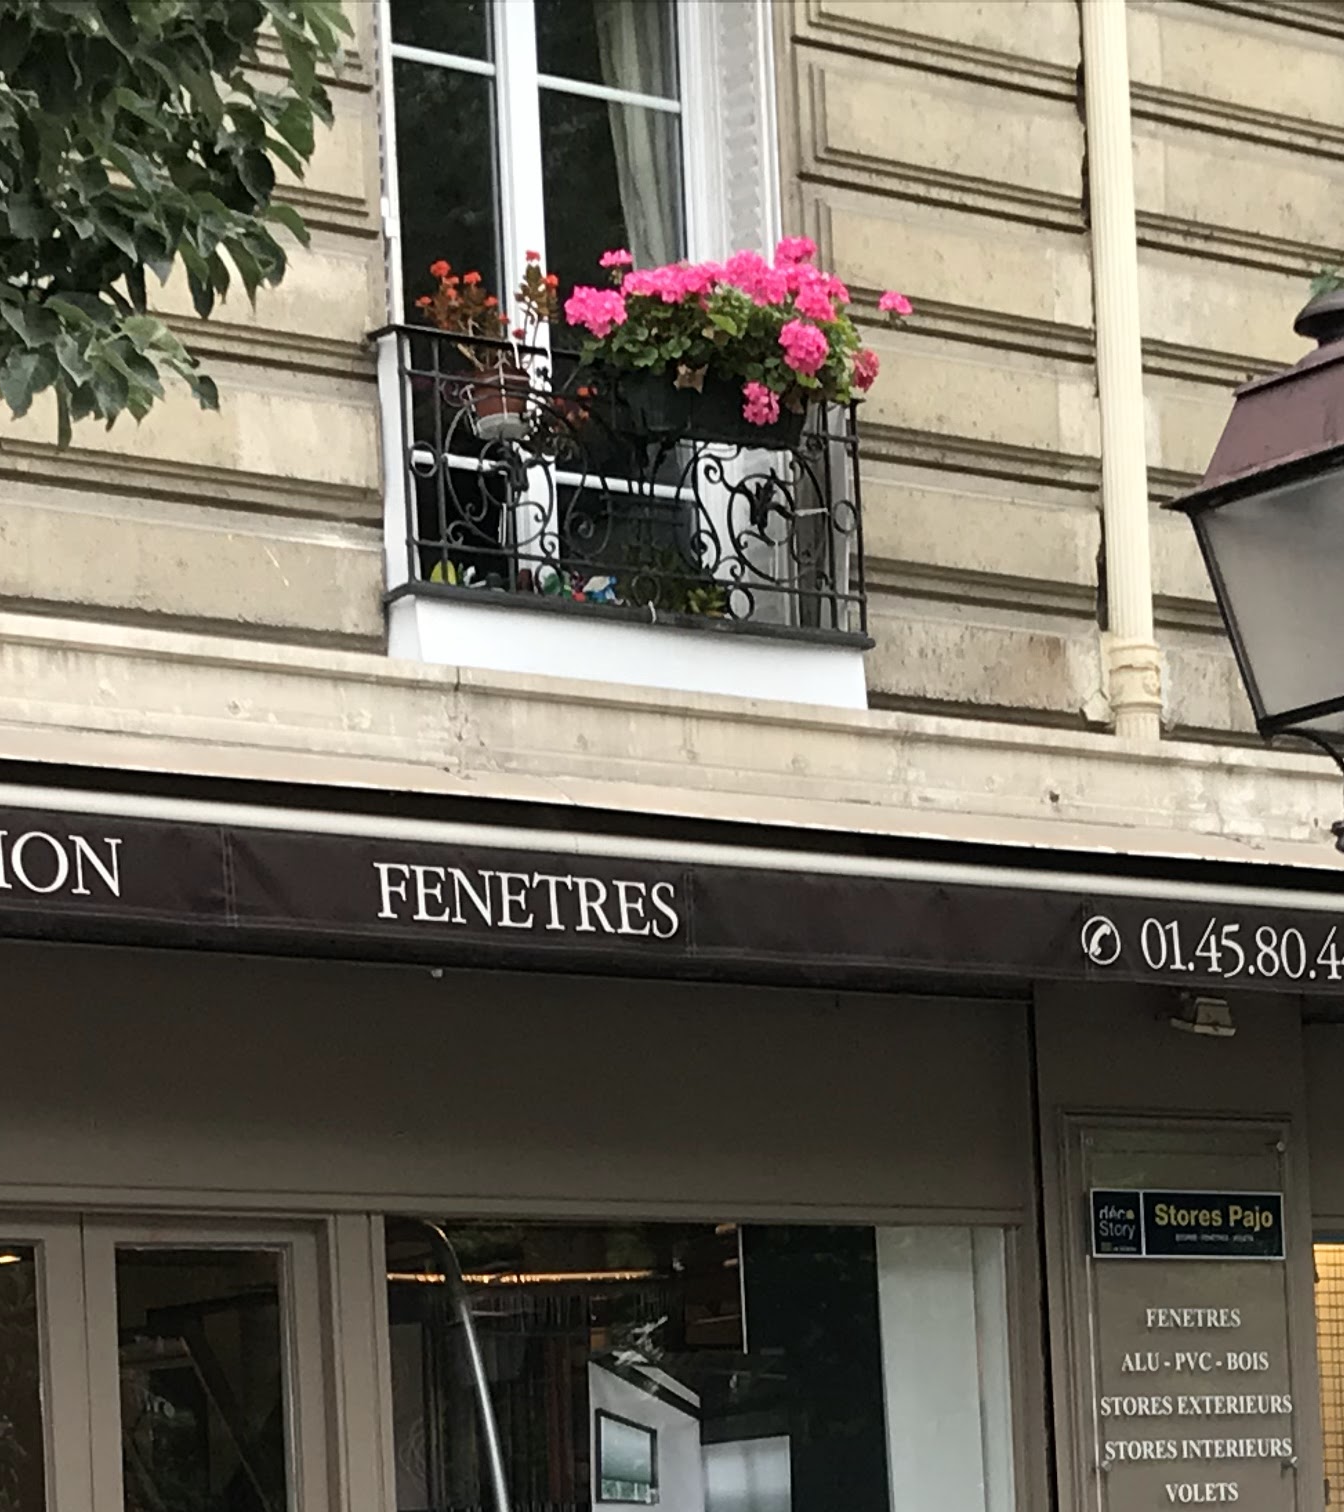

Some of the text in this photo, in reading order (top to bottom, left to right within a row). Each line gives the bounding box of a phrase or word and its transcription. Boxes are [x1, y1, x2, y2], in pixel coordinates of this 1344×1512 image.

[373, 861, 680, 939] FENETRES
[1155, 1203, 1273, 1232] Stores Pajo
[1099, 1220, 1135, 1240] Story
[1146, 1308, 1242, 1328] FENETRES
[1121, 1352, 1160, 1372] ALU
[1175, 1351, 1212, 1371] PVC
[1226, 1351, 1269, 1371] BOIS
[1100, 1394, 1293, 1416] STORES EXTERIEURS
[1105, 1438, 1293, 1461] STORES INTERIEURS
[1165, 1482, 1239, 1503] VOLETS
